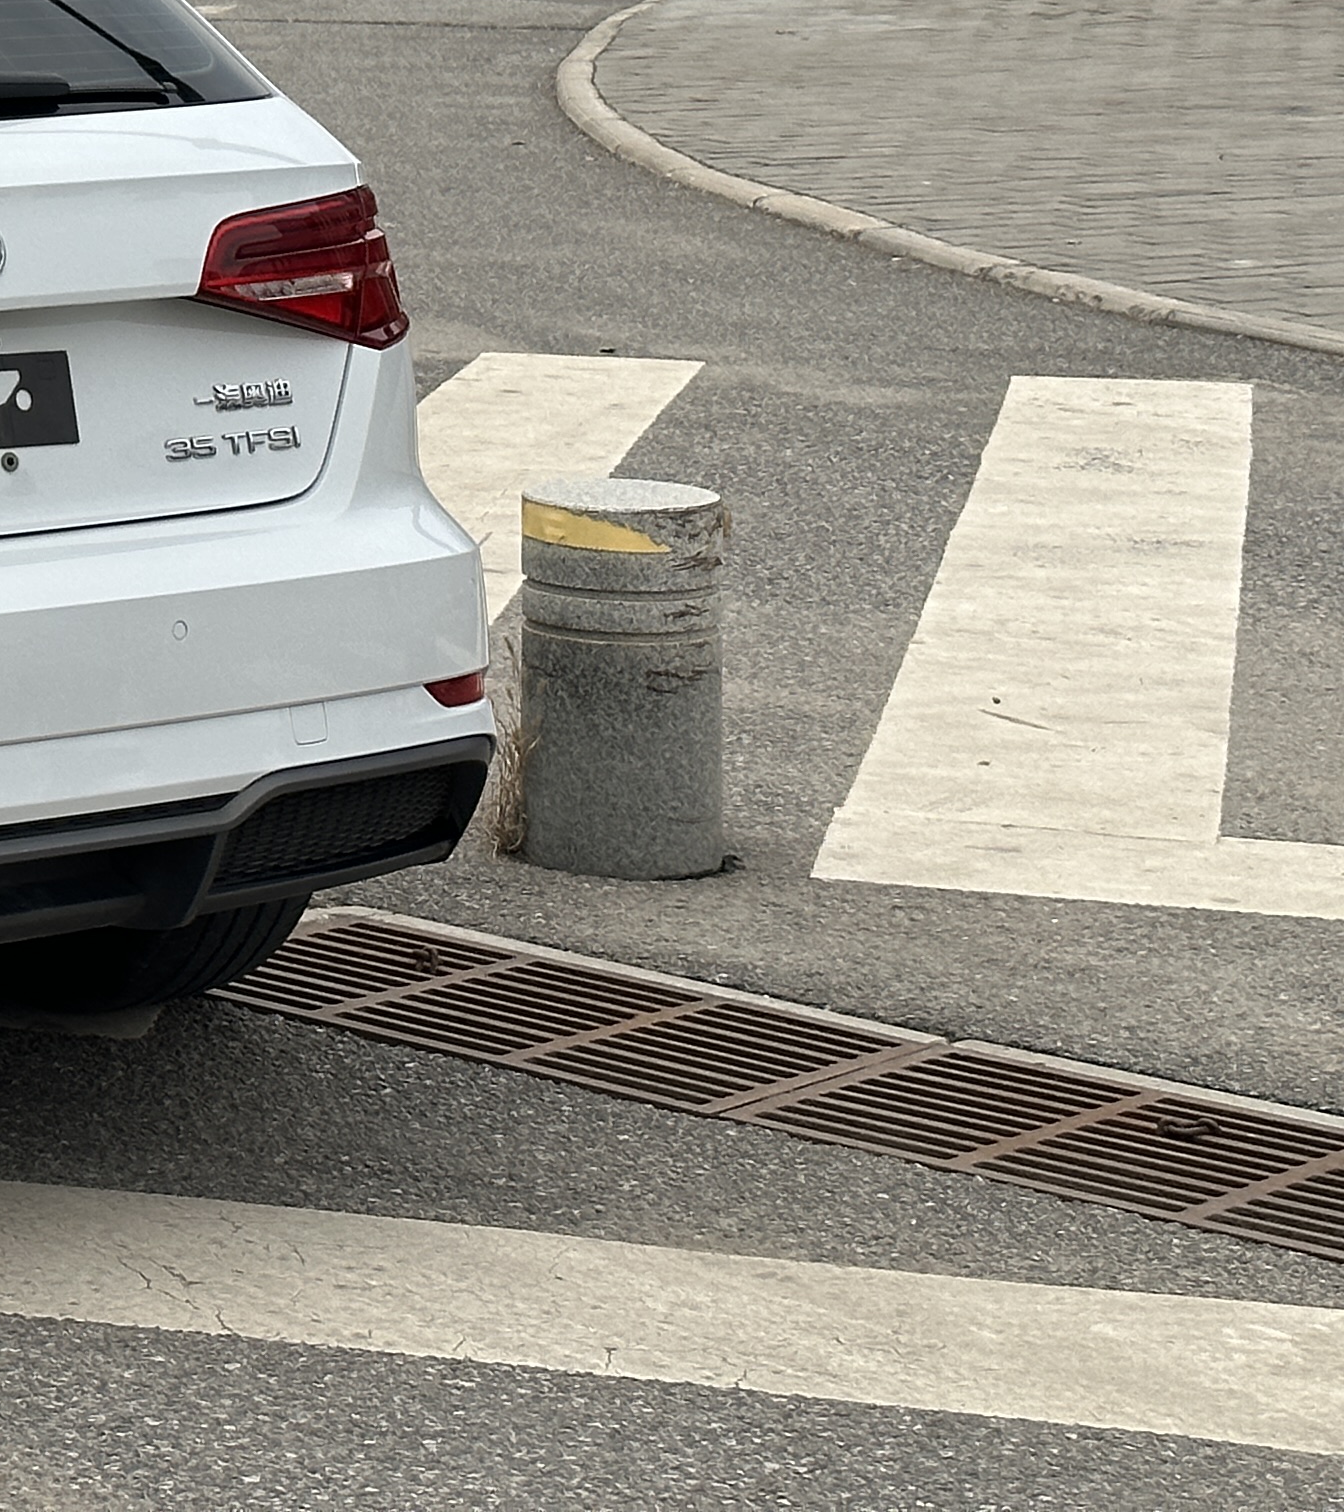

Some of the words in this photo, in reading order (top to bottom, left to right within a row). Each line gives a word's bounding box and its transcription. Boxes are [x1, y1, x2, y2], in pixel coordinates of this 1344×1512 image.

[193, 378, 293, 412] 一汽奥迪
[164, 436, 217, 462] 35
[221, 426, 301, 455] TFSI
